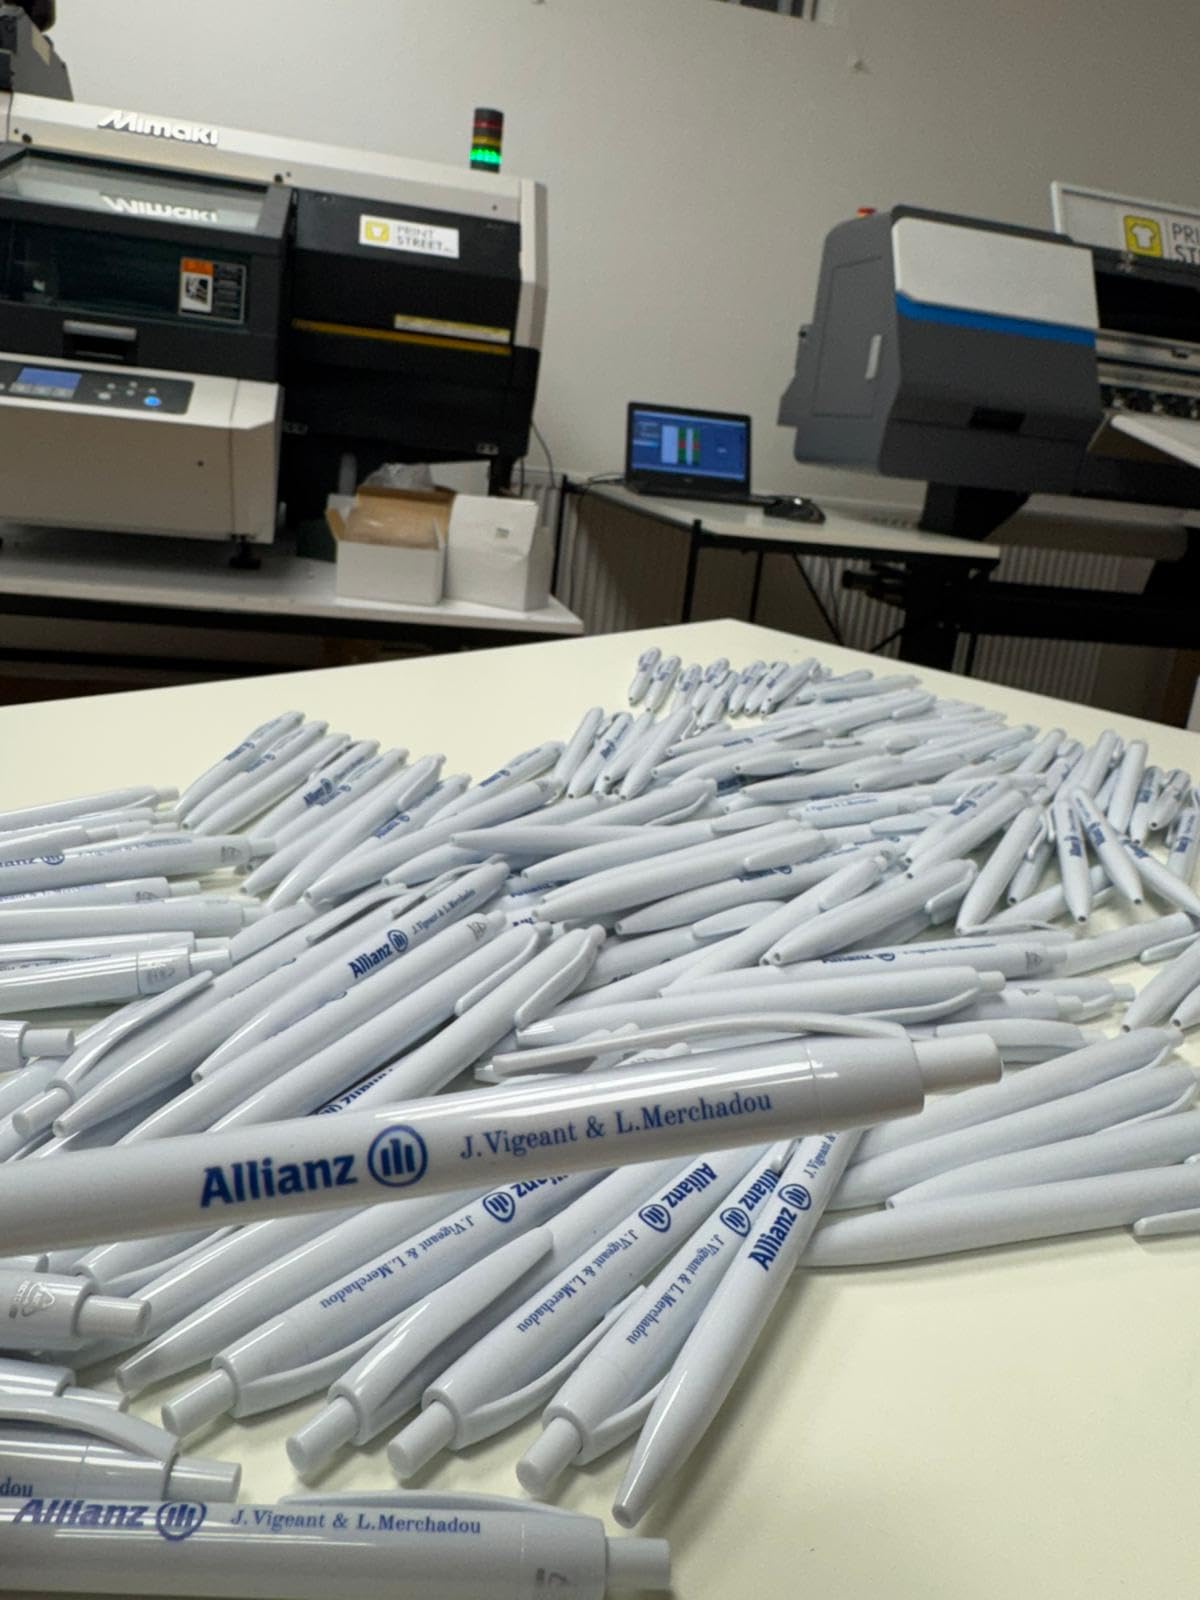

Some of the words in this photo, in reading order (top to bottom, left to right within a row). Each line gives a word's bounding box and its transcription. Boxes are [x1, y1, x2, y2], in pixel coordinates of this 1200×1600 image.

[97, 109, 218, 147] Mimaki
[397, 225, 434, 239] PRINT
[348, 943, 393, 979] Allianz
[201, 1154, 358, 1208] Allianz
[585, 1116, 605, 1139] &
[615, 1091, 773, 1136] L.Merchadou
[661, 1162, 718, 1209] Allianz
[405, 1246, 420, 1260] &
[748, 1206, 798, 1271] Allianz
[582, 1265, 596, 1277] &
[678, 1274, 691, 1286] &
[12, 1499, 149, 1527] Allianz
[332, 1513, 349, 1530] &
[357, 1513, 481, 1535] L.Merchadou
